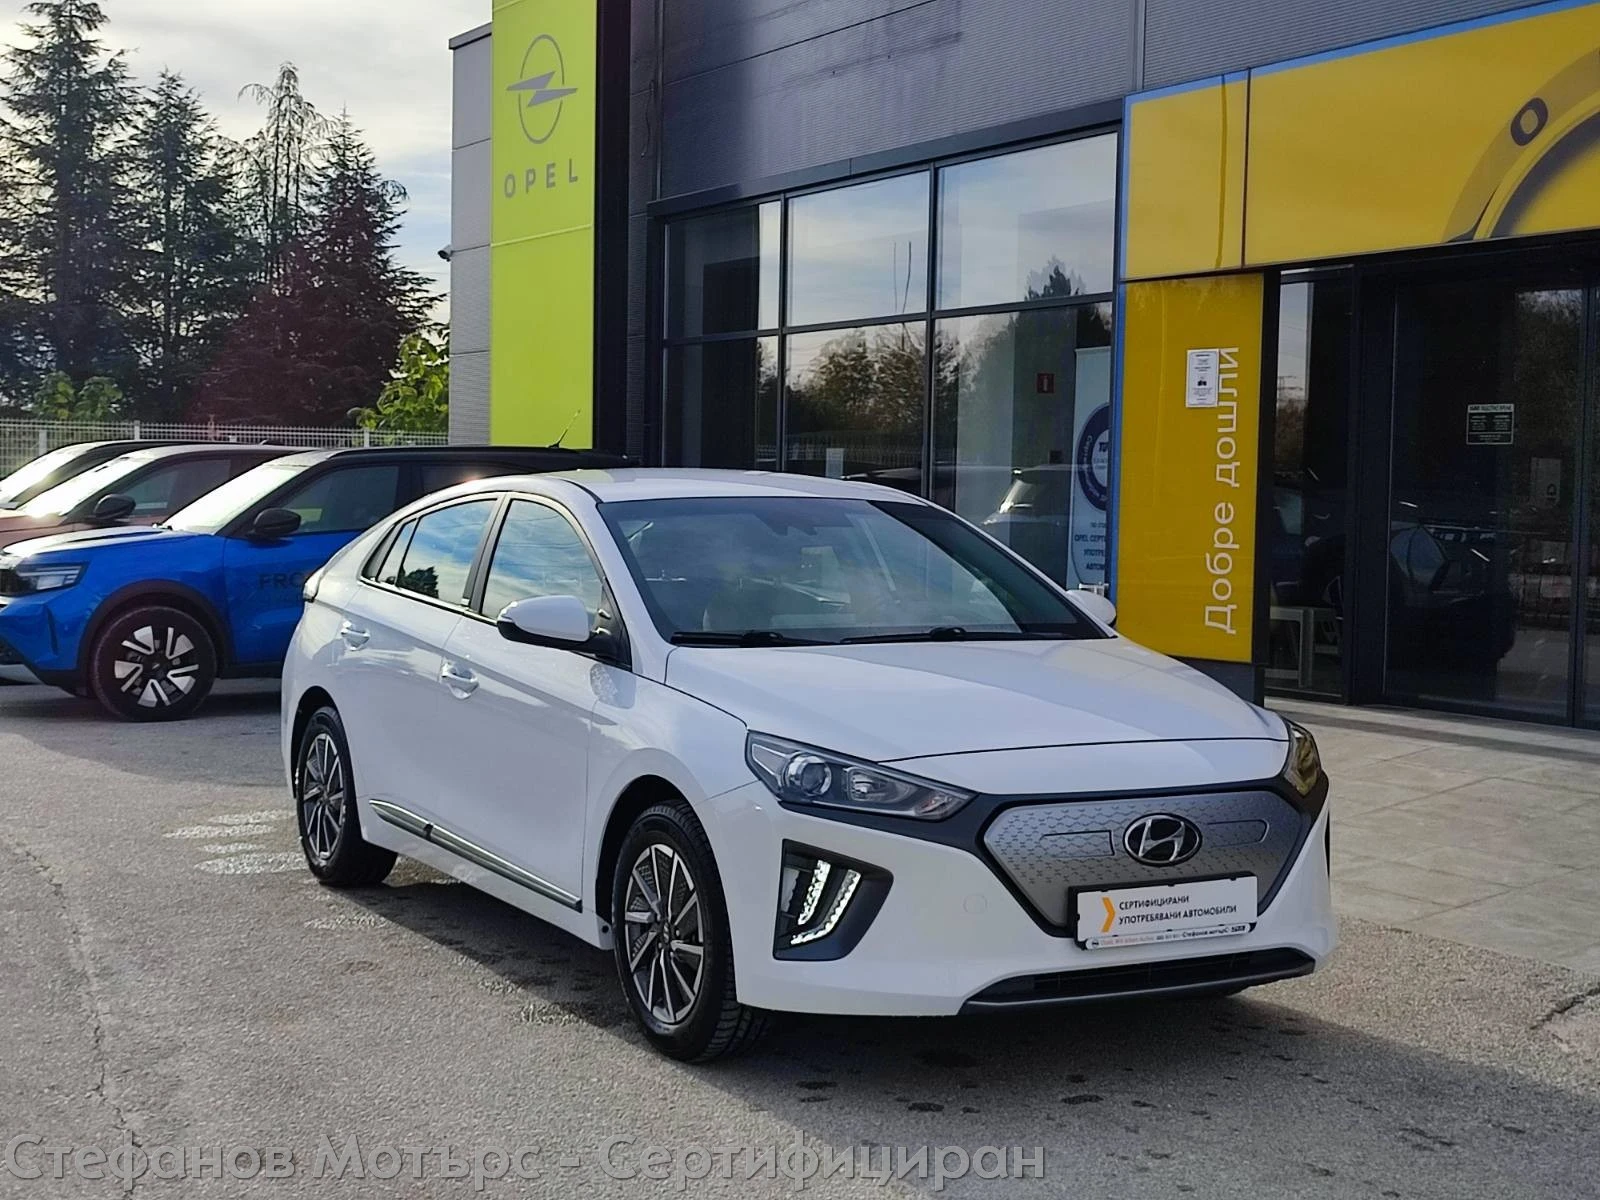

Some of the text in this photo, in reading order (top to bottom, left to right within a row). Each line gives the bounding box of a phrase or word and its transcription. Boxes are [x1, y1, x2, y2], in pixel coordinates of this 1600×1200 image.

[504, 158, 578, 198] OPEL
[1204, 347, 1240, 634] Добре дошли
[1118, 905, 1237, 925] УПОТРЕБЯВАНИ АВТОМОБИЛИ
[1119, 895, 1189, 910] СЕРТИФИЦИРАНИ
